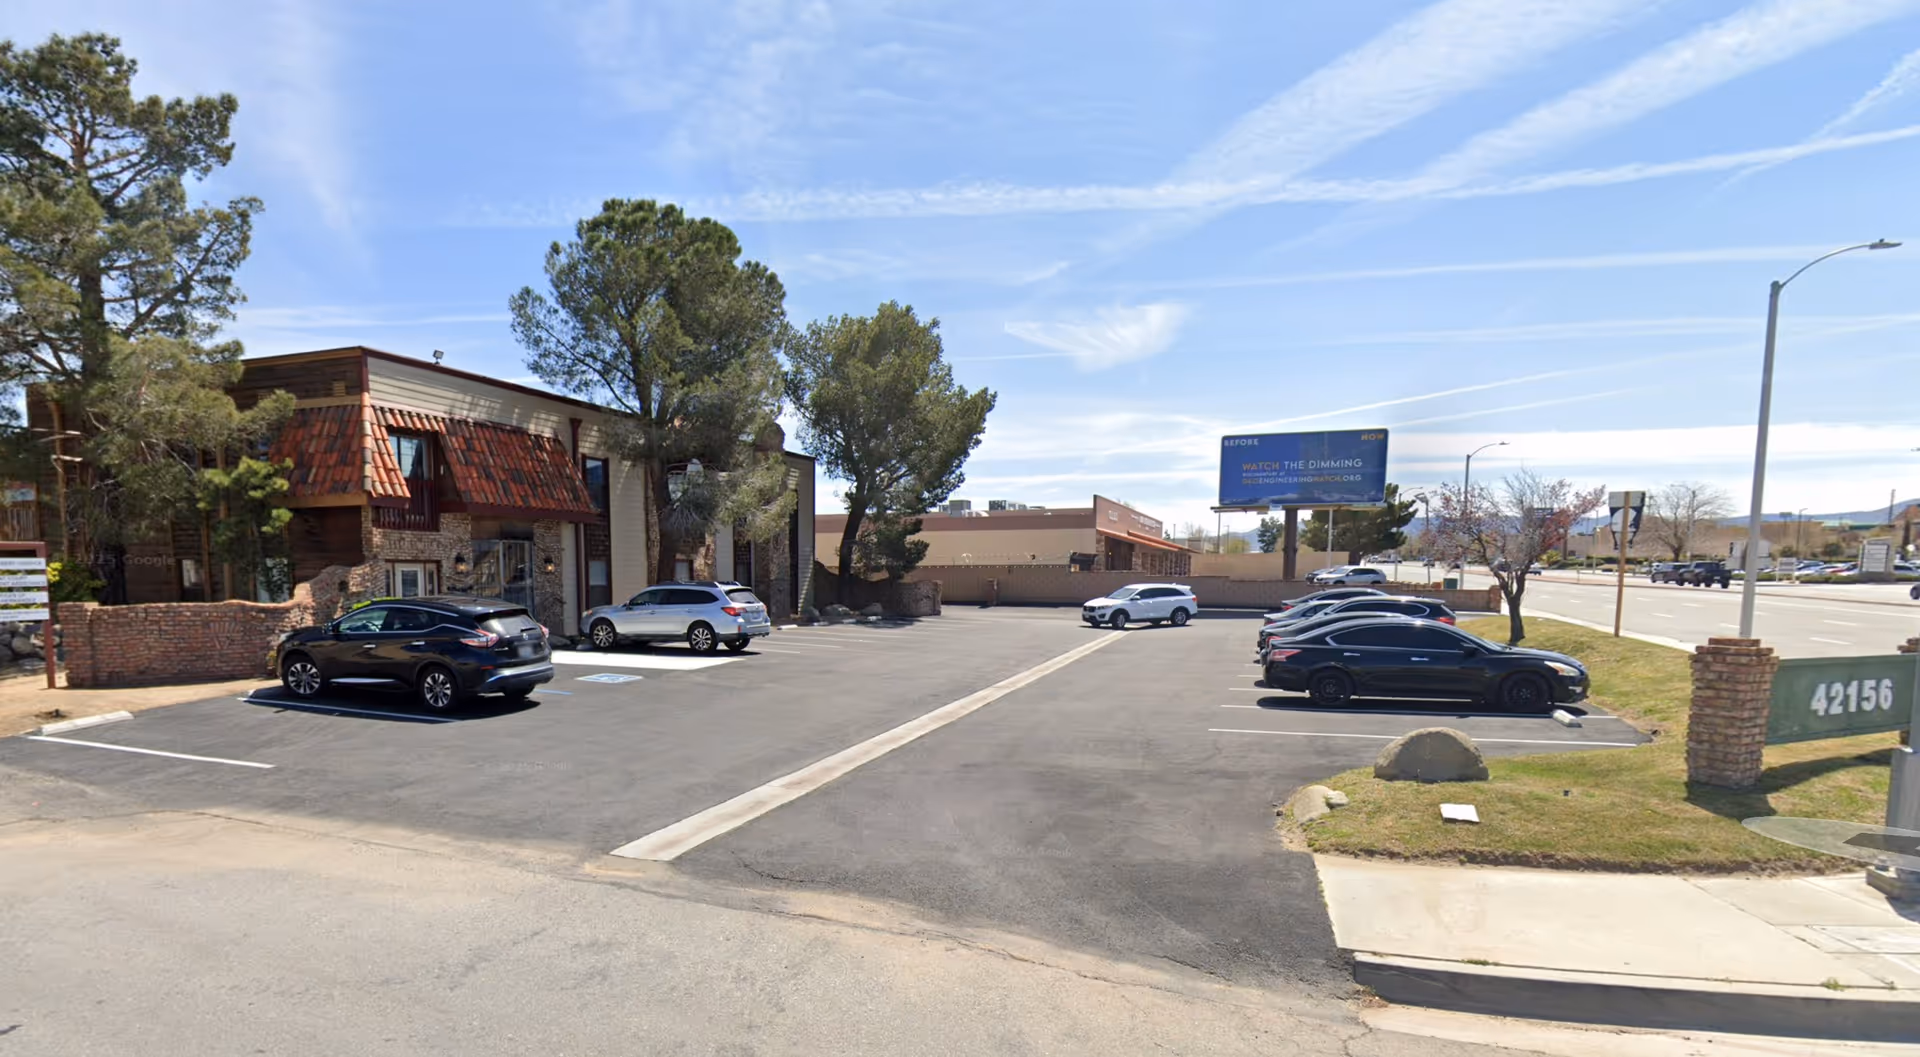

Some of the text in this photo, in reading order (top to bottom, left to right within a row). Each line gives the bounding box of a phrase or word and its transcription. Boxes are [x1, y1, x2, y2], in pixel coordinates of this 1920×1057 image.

[1224, 438, 1259, 447] BEFORE
[1242, 458, 1362, 471] WATCH THE DIMMING
[1810, 678, 1893, 716] 42156
